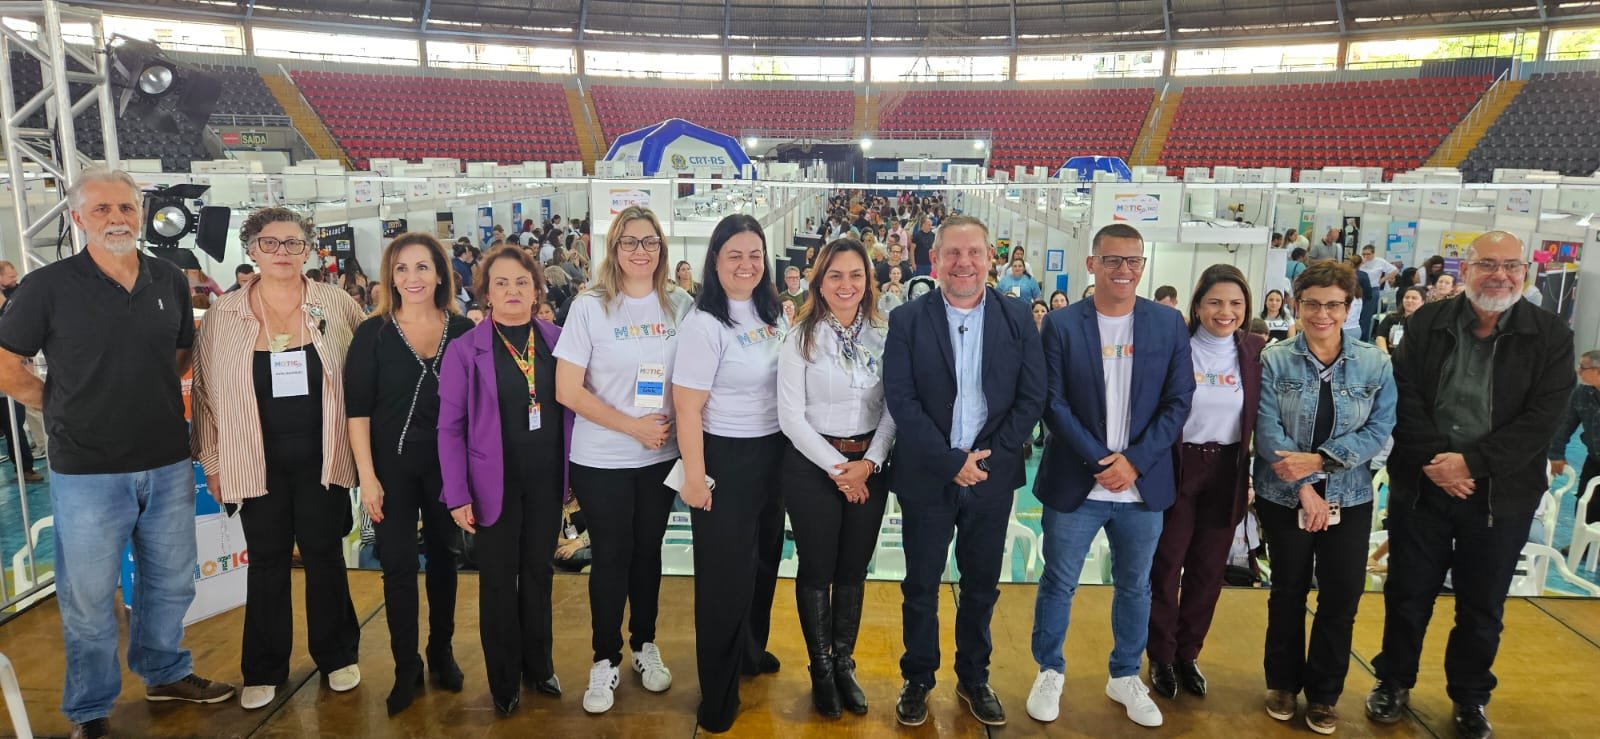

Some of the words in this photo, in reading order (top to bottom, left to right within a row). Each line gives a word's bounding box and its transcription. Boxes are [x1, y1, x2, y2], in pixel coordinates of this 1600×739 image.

[242, 135, 266, 144] SAÍDA
[689, 156, 725, 165] CRT-RS
[614, 323, 667, 338] MOTIC
[1103, 344, 1135, 358] OTI
[1195, 371, 1237, 385] OTIC
